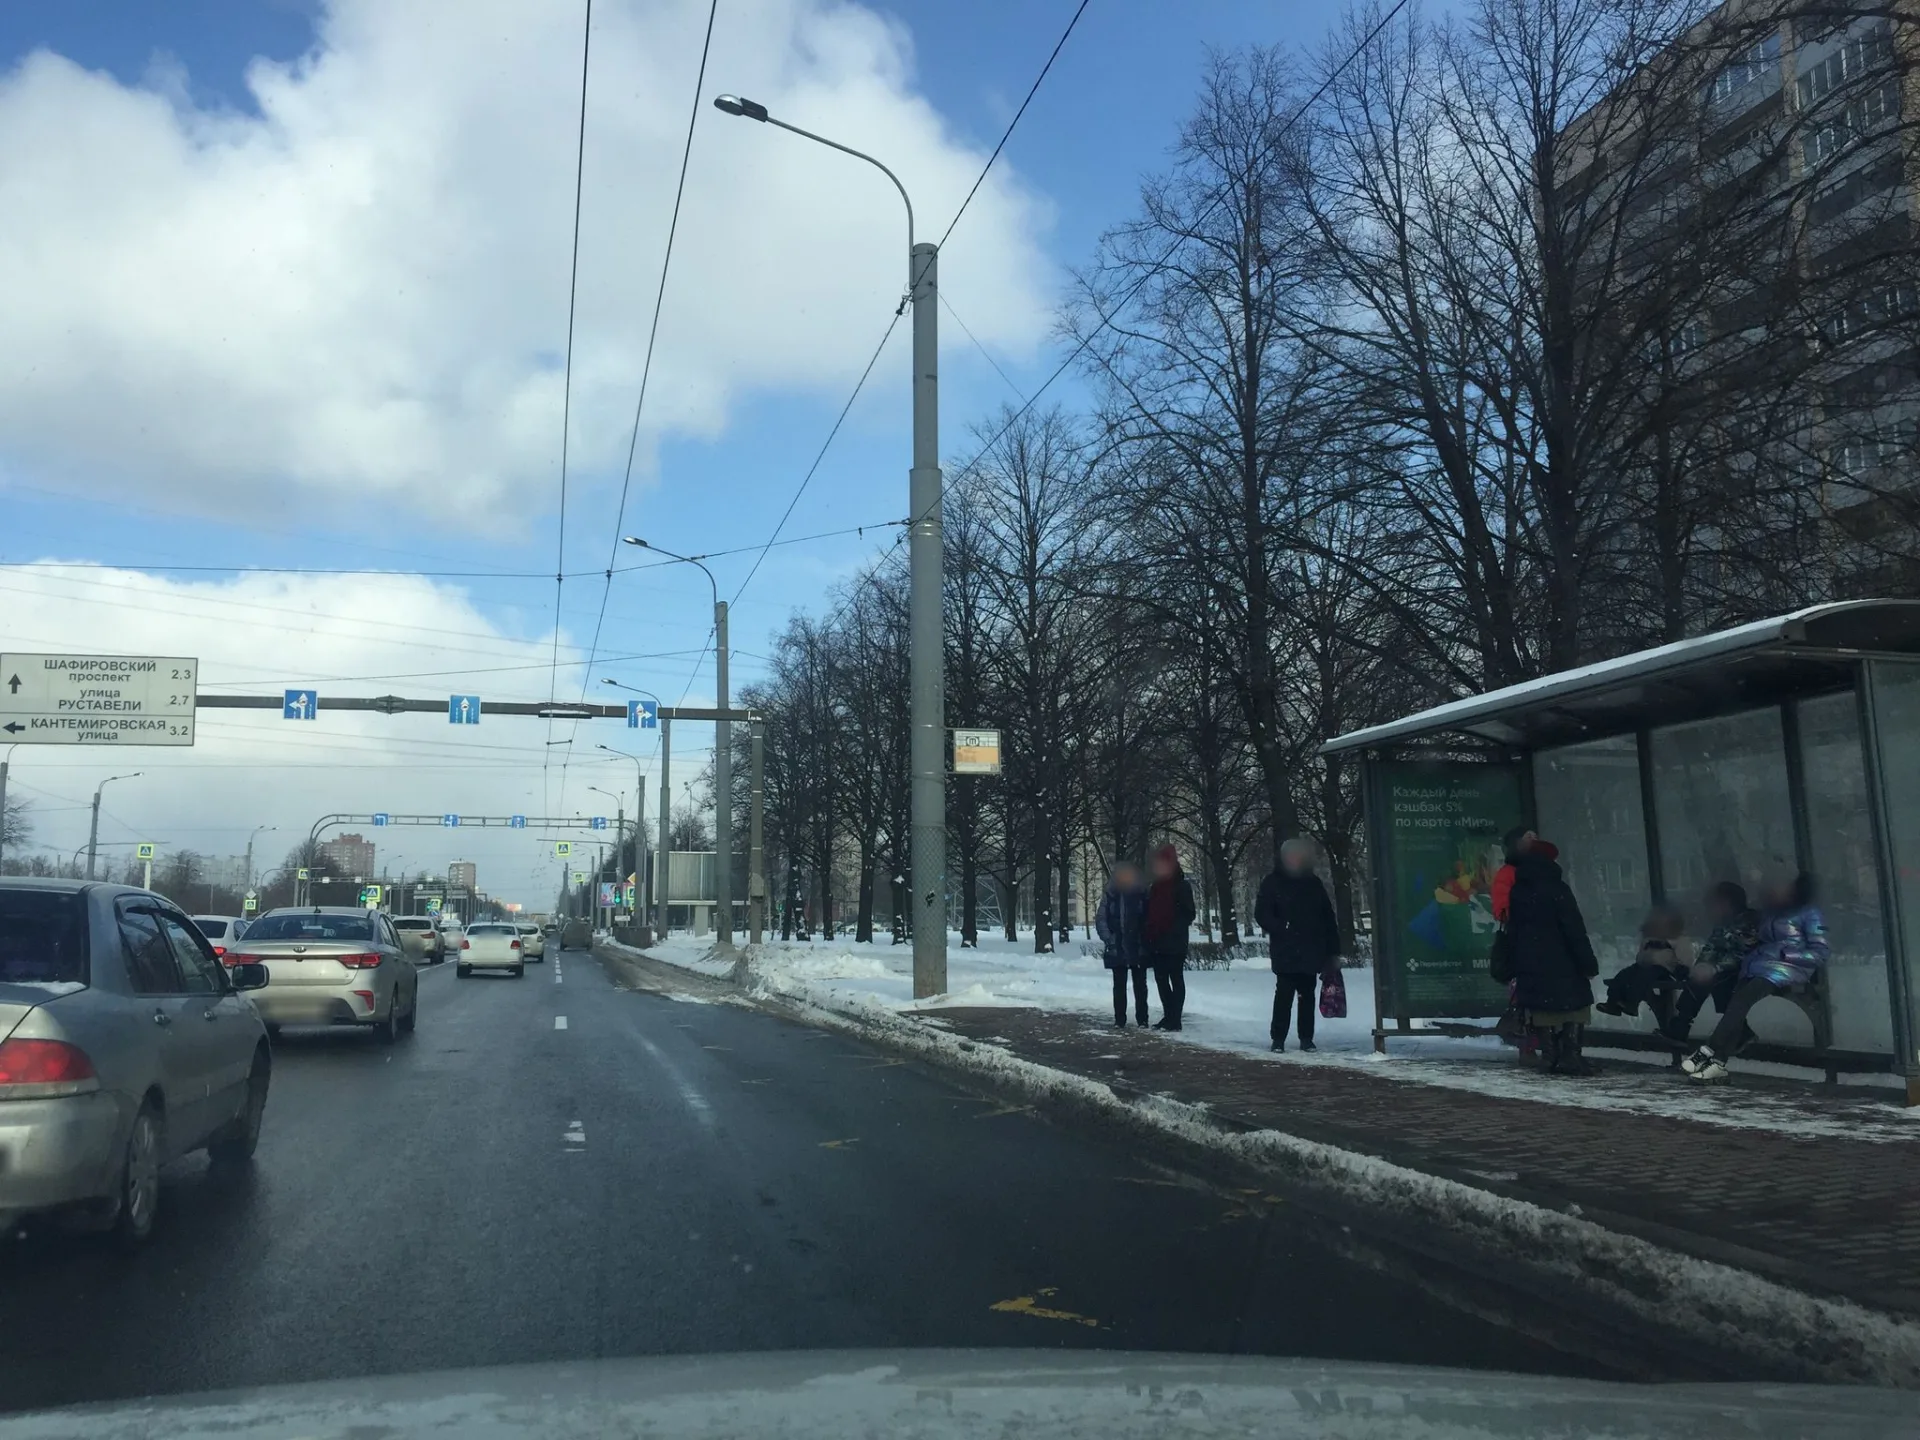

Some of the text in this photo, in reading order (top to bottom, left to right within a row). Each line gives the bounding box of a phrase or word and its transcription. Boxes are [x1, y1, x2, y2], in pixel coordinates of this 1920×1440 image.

[44, 659, 157, 672] ШАФИРОВСКИЙ
[69, 672, 131, 683] проспект
[171, 669, 191, 680] 2.3
[80, 688, 121, 699] улица
[58, 700, 142, 711] РУСТАВЕЛИ
[169, 695, 189, 706] 2.7
[31, 718, 166, 730] КАНТЕМИРОВСКАЯ
[77, 730, 118, 741] улица
[169, 726, 189, 736] 3.2
[1393, 786, 1480, 798] Каждый день
[1394, 801, 1463, 812] кэшбэк 5%
[1395, 818, 1411, 827] по
[1414, 817, 1451, 829] карте
[1472, 958, 1491, 968] МИ
